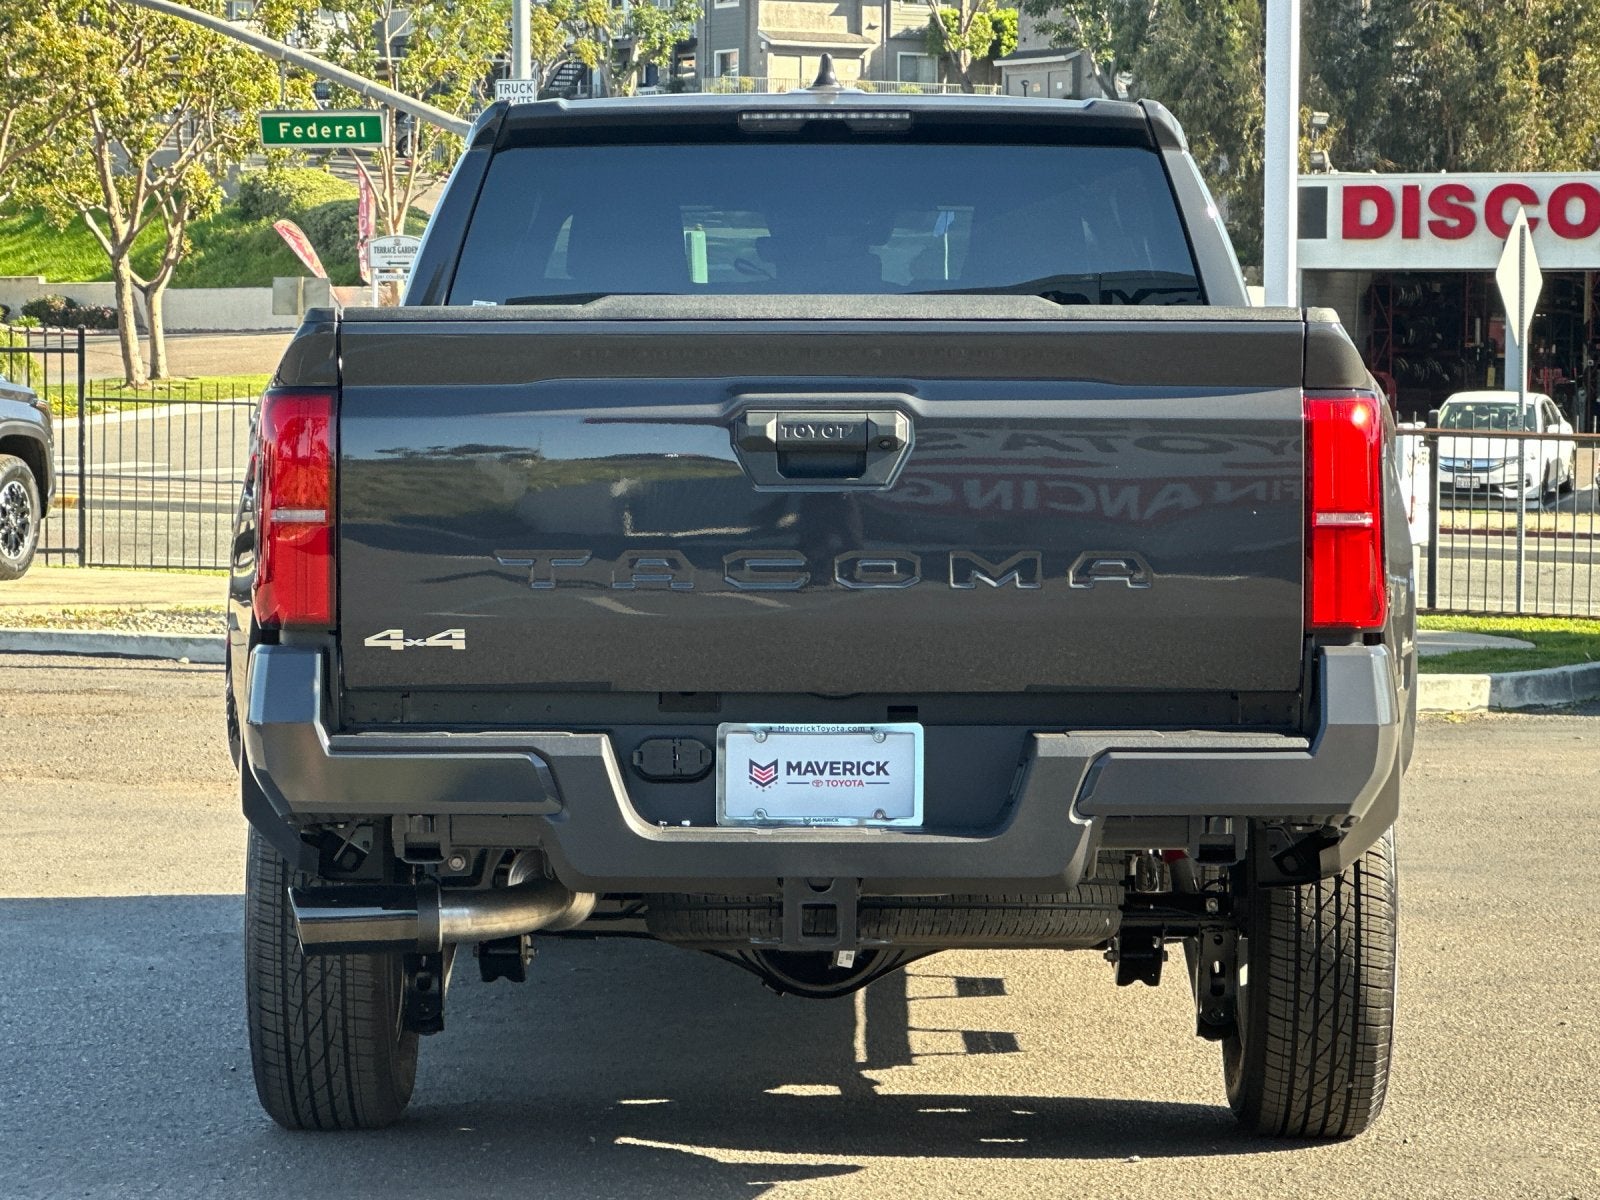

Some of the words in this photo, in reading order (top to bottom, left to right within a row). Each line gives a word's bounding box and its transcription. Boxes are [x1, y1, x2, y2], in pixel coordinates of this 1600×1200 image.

[498, 83, 533, 94] TRUCK
[279, 122, 365, 138] Federal
[1342, 183, 1600, 240] DISCO
[373, 246, 396, 254] TERRACE
[781, 424, 855, 438] TOYOT
[496, 549, 1153, 590] TACOMA
[778, 725, 865, 733] MaverickToyota.com
[786, 761, 890, 776] MAVERICK
[825, 779, 865, 788] TOYOTA
